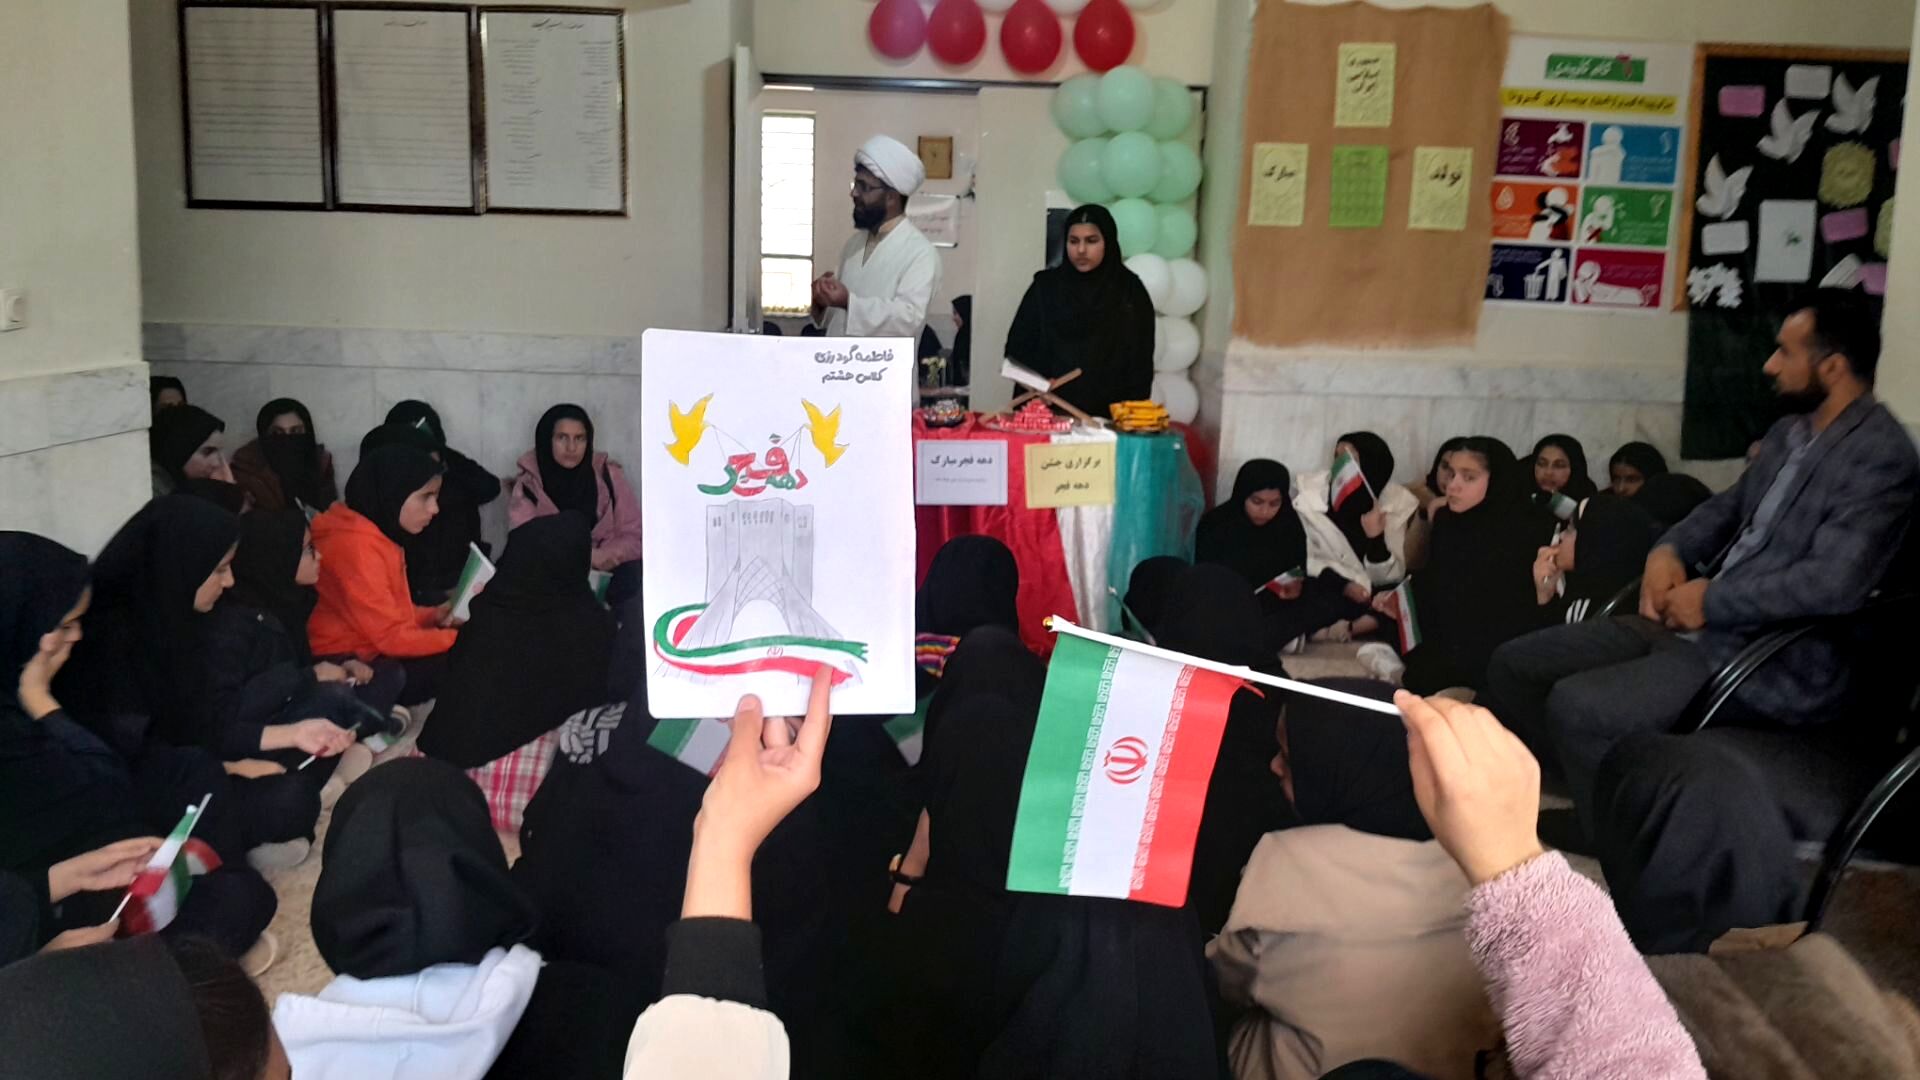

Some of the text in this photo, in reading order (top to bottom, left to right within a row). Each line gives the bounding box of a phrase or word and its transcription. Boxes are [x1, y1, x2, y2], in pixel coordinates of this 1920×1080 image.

[814, 344, 894, 364] فاطمه گودرزی
[821, 367, 888, 384] کلاس هشتم
[697, 433, 790, 497] فجر
[930, 455, 993, 468] دهه فجر مبارک
[1040, 456, 1101, 470] برگزاری جشن
[1054, 481, 1071, 495] فجر
